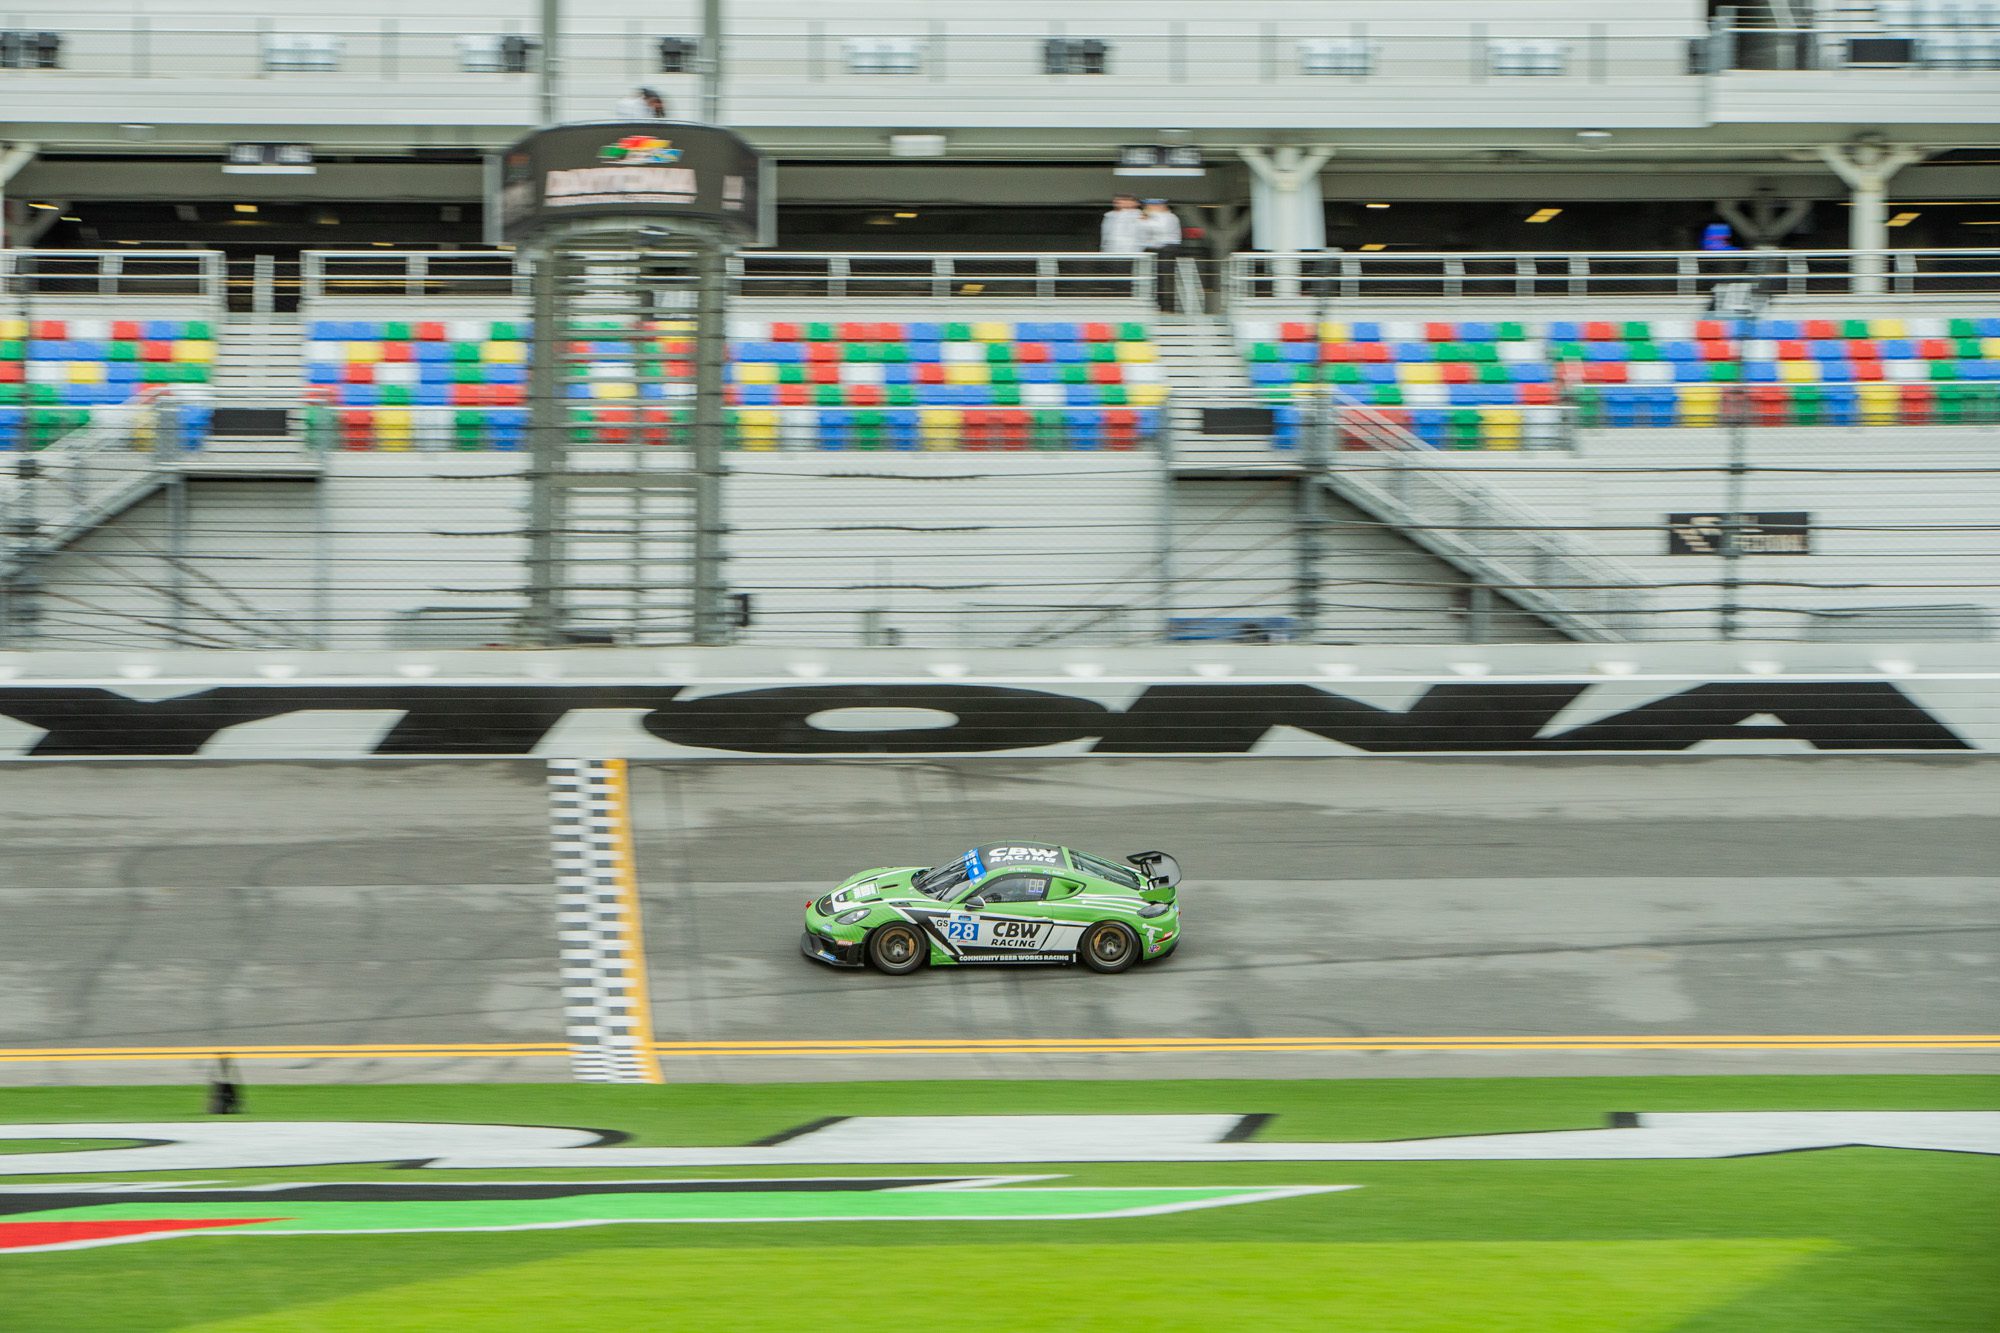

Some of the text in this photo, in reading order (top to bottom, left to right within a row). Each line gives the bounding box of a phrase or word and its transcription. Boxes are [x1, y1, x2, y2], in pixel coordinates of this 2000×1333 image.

[989, 847, 1058, 857] CBW
[990, 855, 1056, 863] RACING
[949, 923, 975, 940] 28
[993, 922, 1040, 938] CBW
[990, 938, 1036, 948] RACING
[959, 954, 999, 962] COMMUNITY
